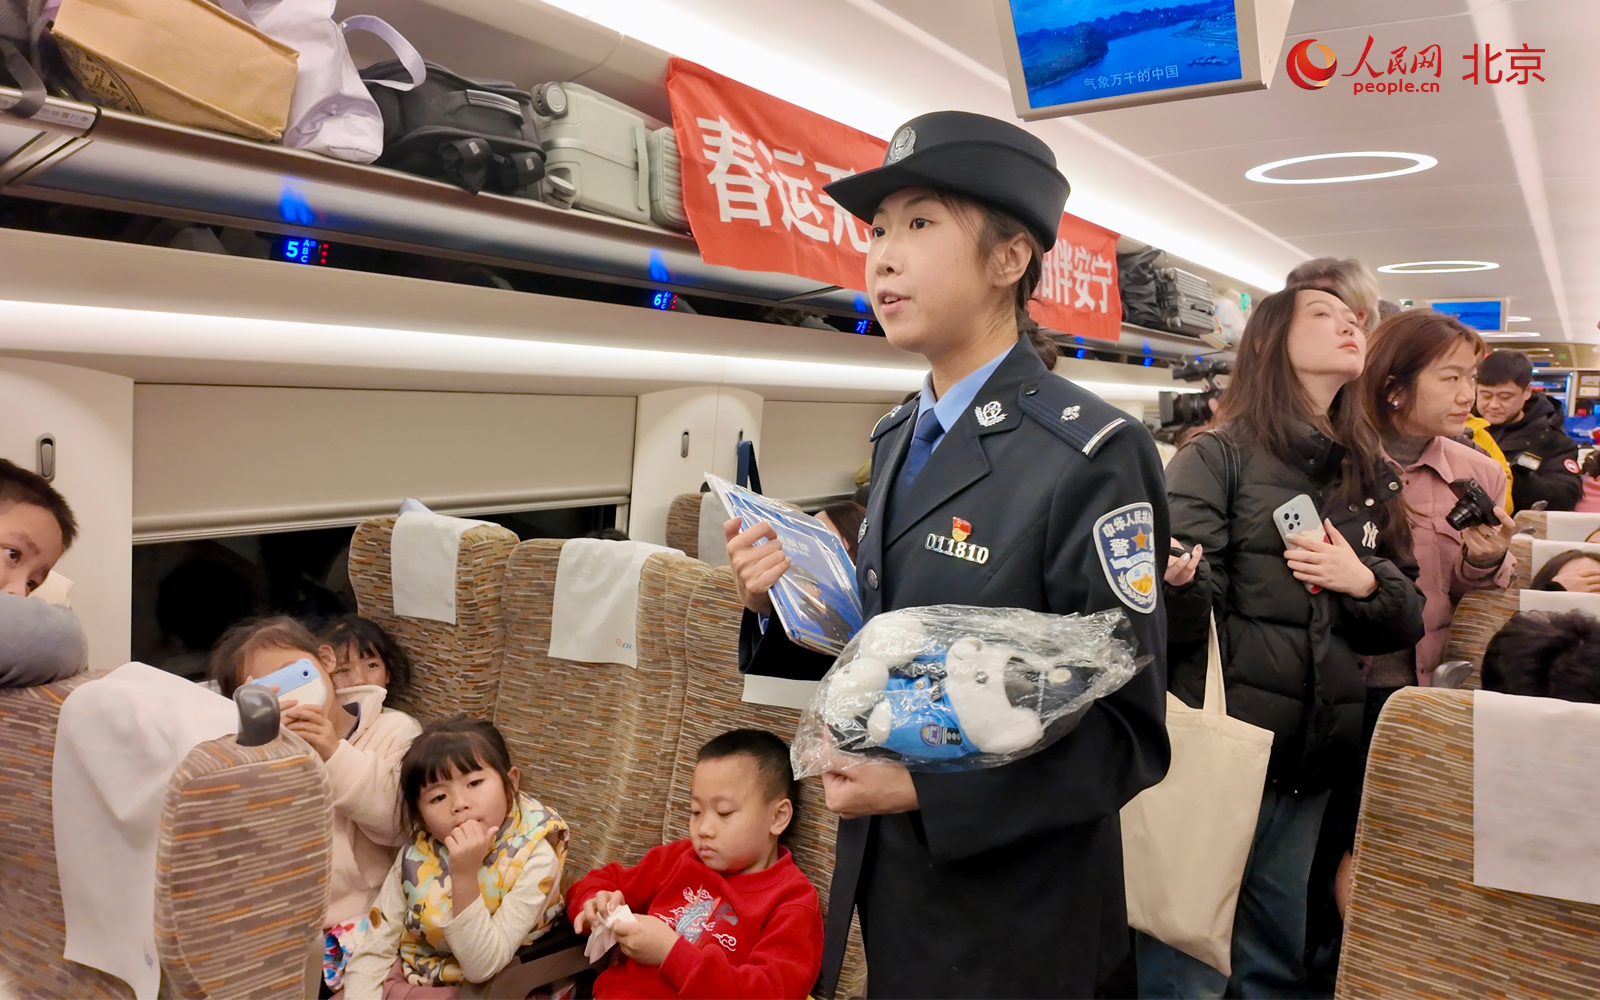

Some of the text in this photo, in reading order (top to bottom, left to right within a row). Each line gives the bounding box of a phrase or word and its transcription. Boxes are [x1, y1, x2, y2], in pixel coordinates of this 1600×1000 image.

[1083, 64, 1179, 91] 气象万千的中国
[286, 241, 299, 258] 5
[925, 533, 989, 564] 011810
